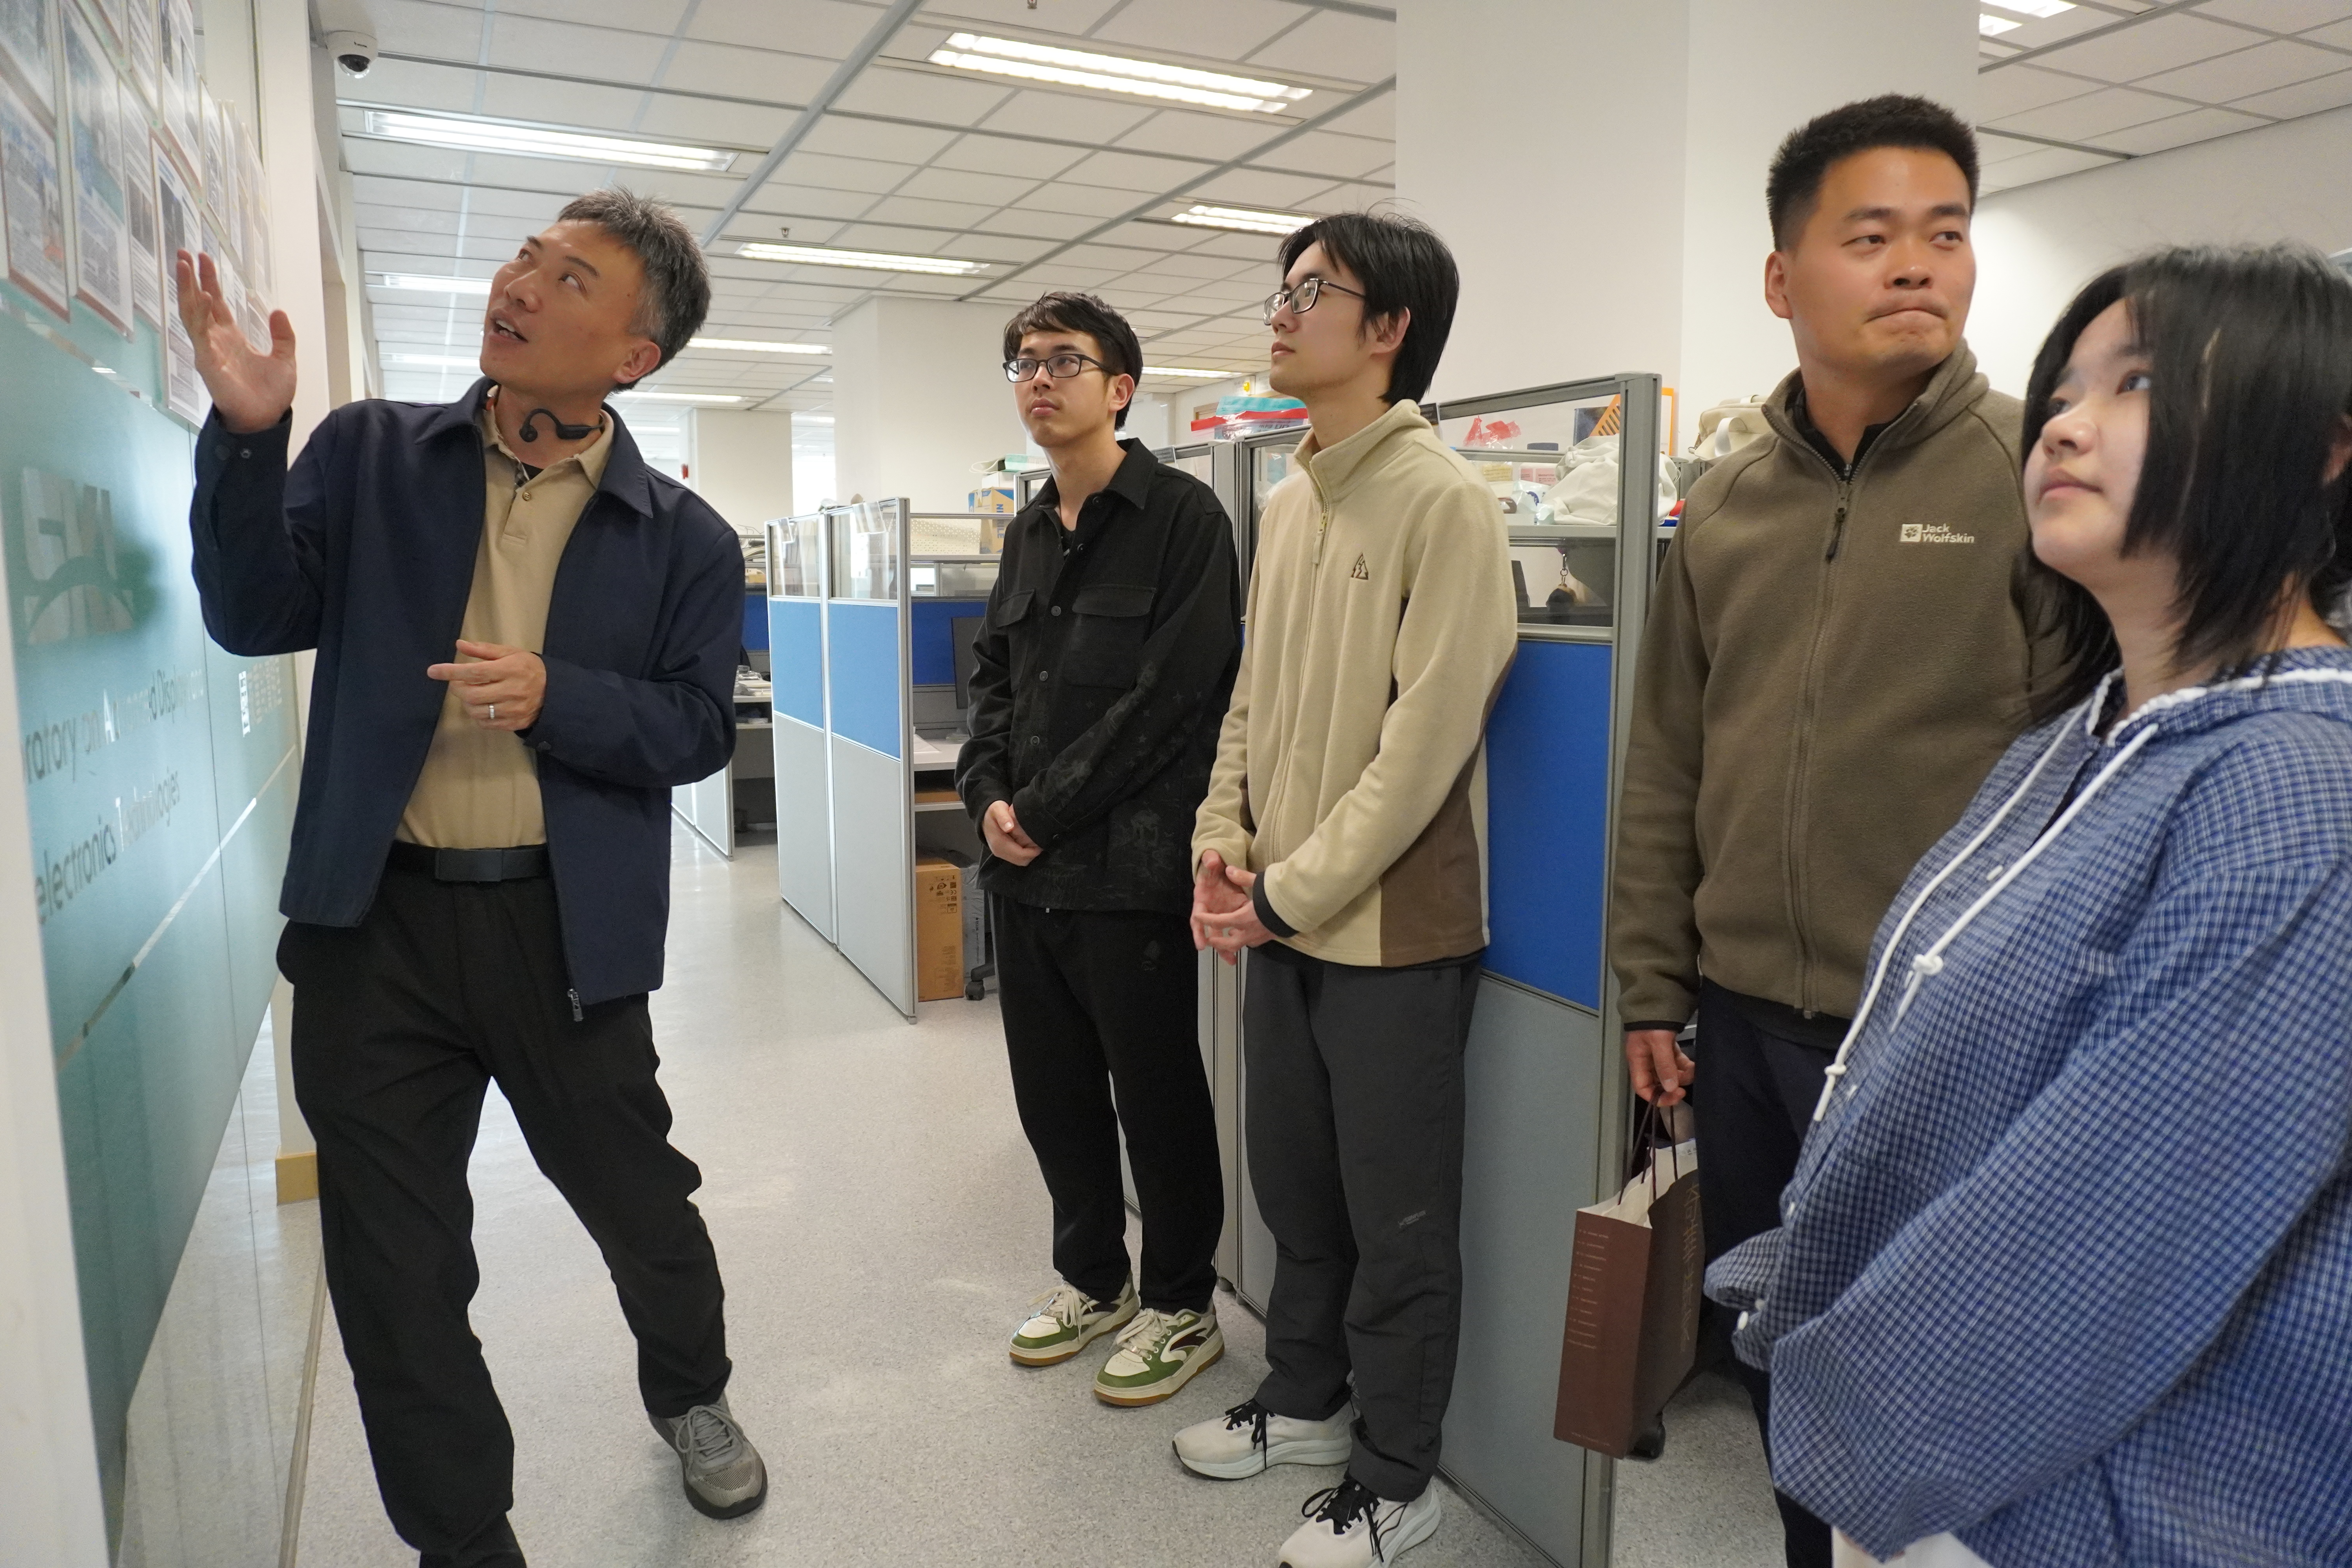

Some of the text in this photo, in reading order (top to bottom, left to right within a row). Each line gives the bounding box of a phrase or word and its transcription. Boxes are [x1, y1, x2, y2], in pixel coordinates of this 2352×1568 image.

[996, 504, 1005, 539] NIILE
[1922, 523, 1950, 533] Jack
[1923, 533, 1975, 543] Wolfskin
